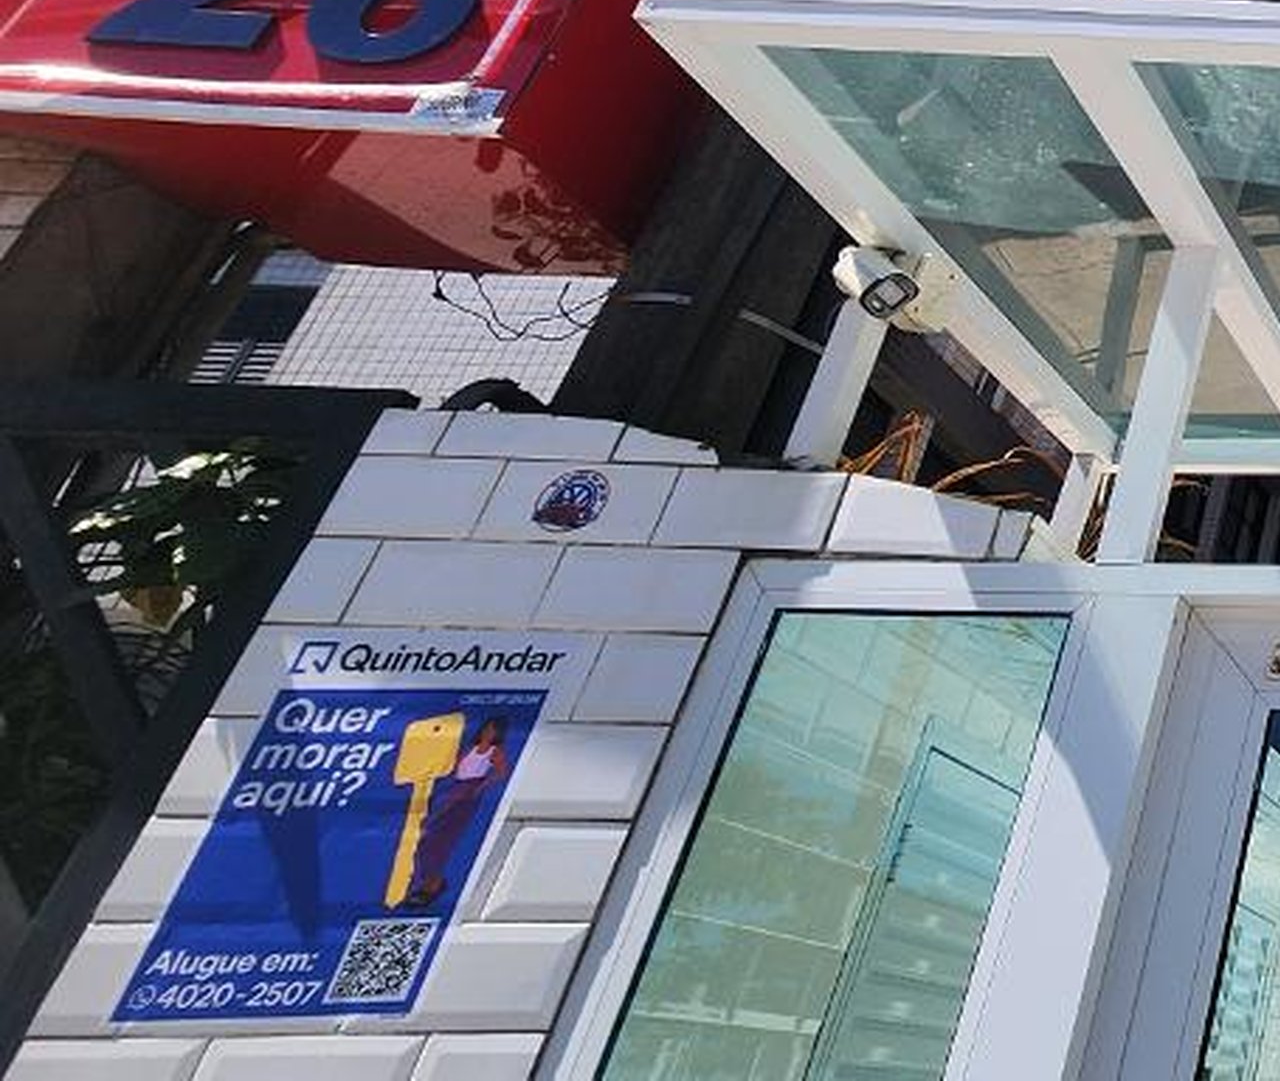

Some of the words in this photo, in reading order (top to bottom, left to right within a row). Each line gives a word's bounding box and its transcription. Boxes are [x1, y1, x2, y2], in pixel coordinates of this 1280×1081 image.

[339, 642, 567, 674] QuintoAndar
[274, 697, 392, 734] Quer
[250, 741, 396, 771] morar
[232, 770, 368, 817] aqui?
[143, 948, 258, 981] Alugue
[260, 951, 320, 973] em:
[156, 979, 324, 1010] 4020-2507
